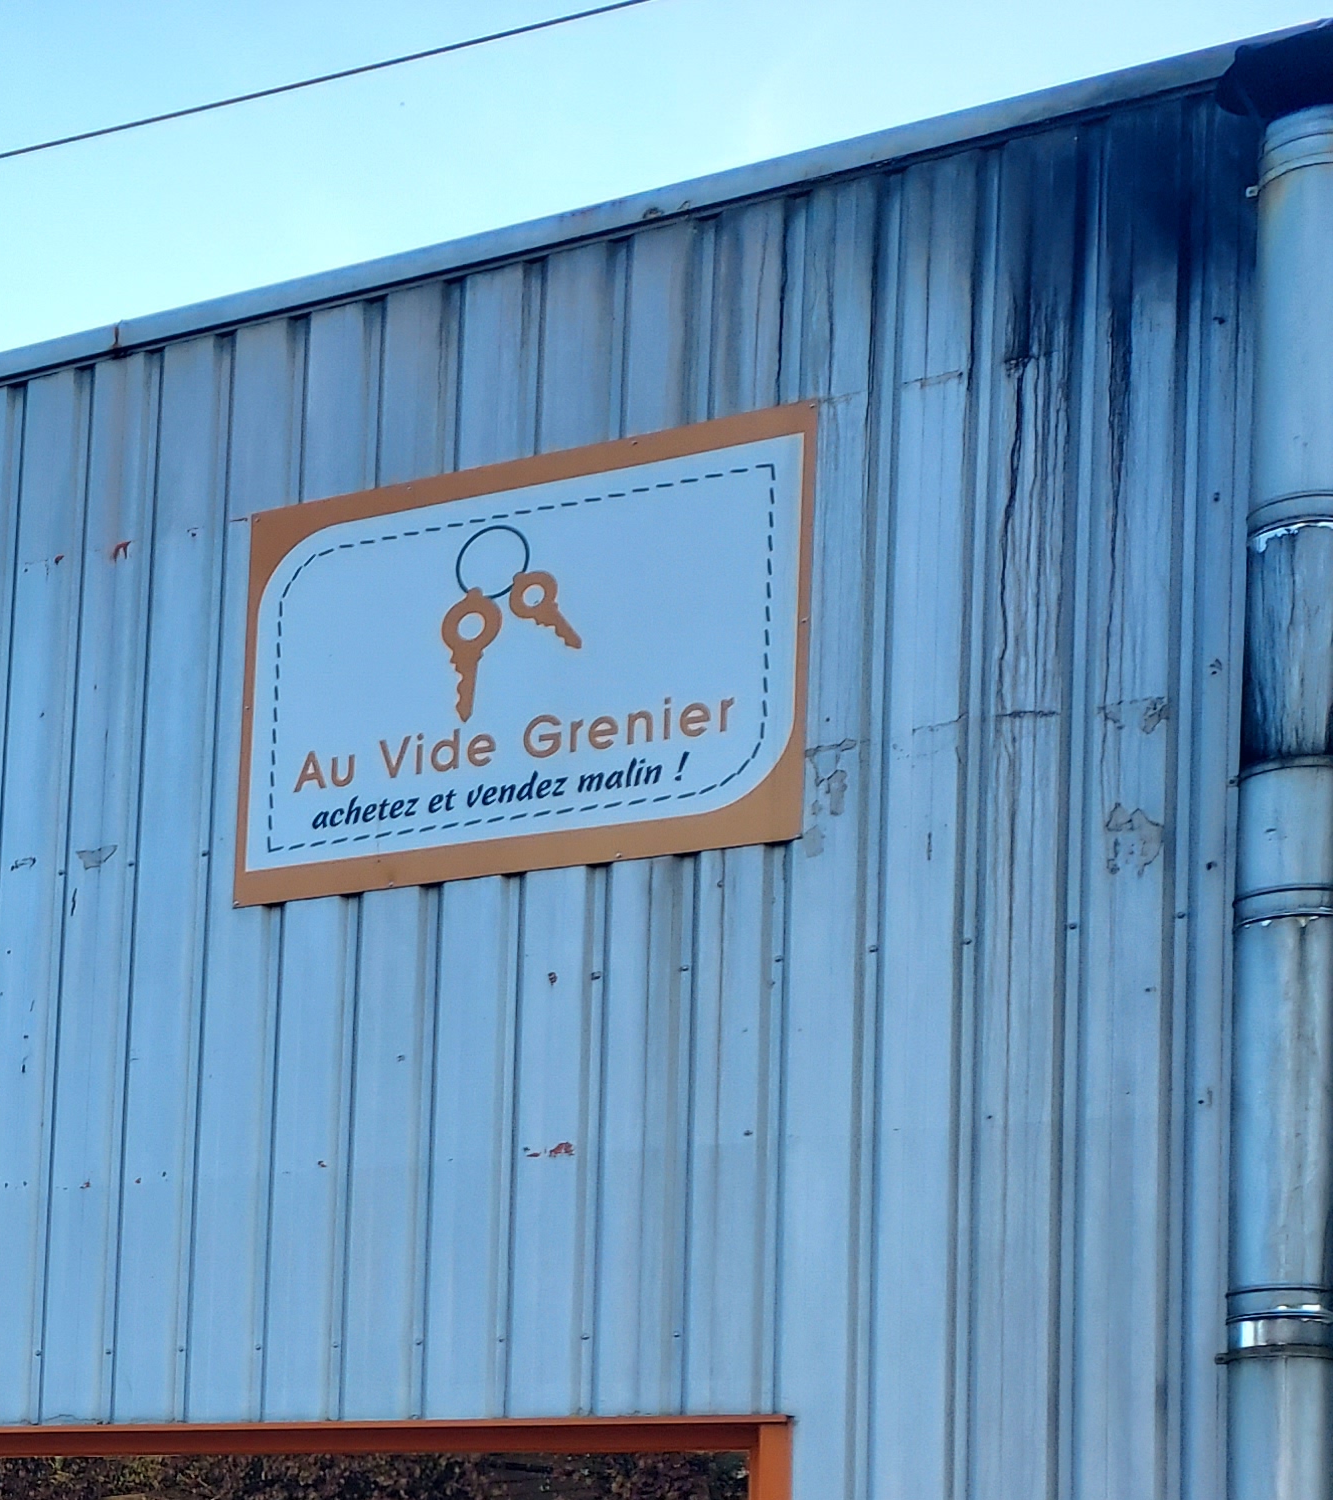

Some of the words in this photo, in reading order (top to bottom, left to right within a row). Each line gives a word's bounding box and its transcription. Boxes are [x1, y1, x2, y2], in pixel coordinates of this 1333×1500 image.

[294, 749, 355, 793] Au
[379, 727, 496, 779] Vide
[522, 696, 735, 760] Grenier
[311, 795, 417, 830] achetez
[427, 788, 457, 814] et
[466, 770, 567, 808] vendez
[577, 757, 663, 793] malin
[674, 751, 690, 782] !
